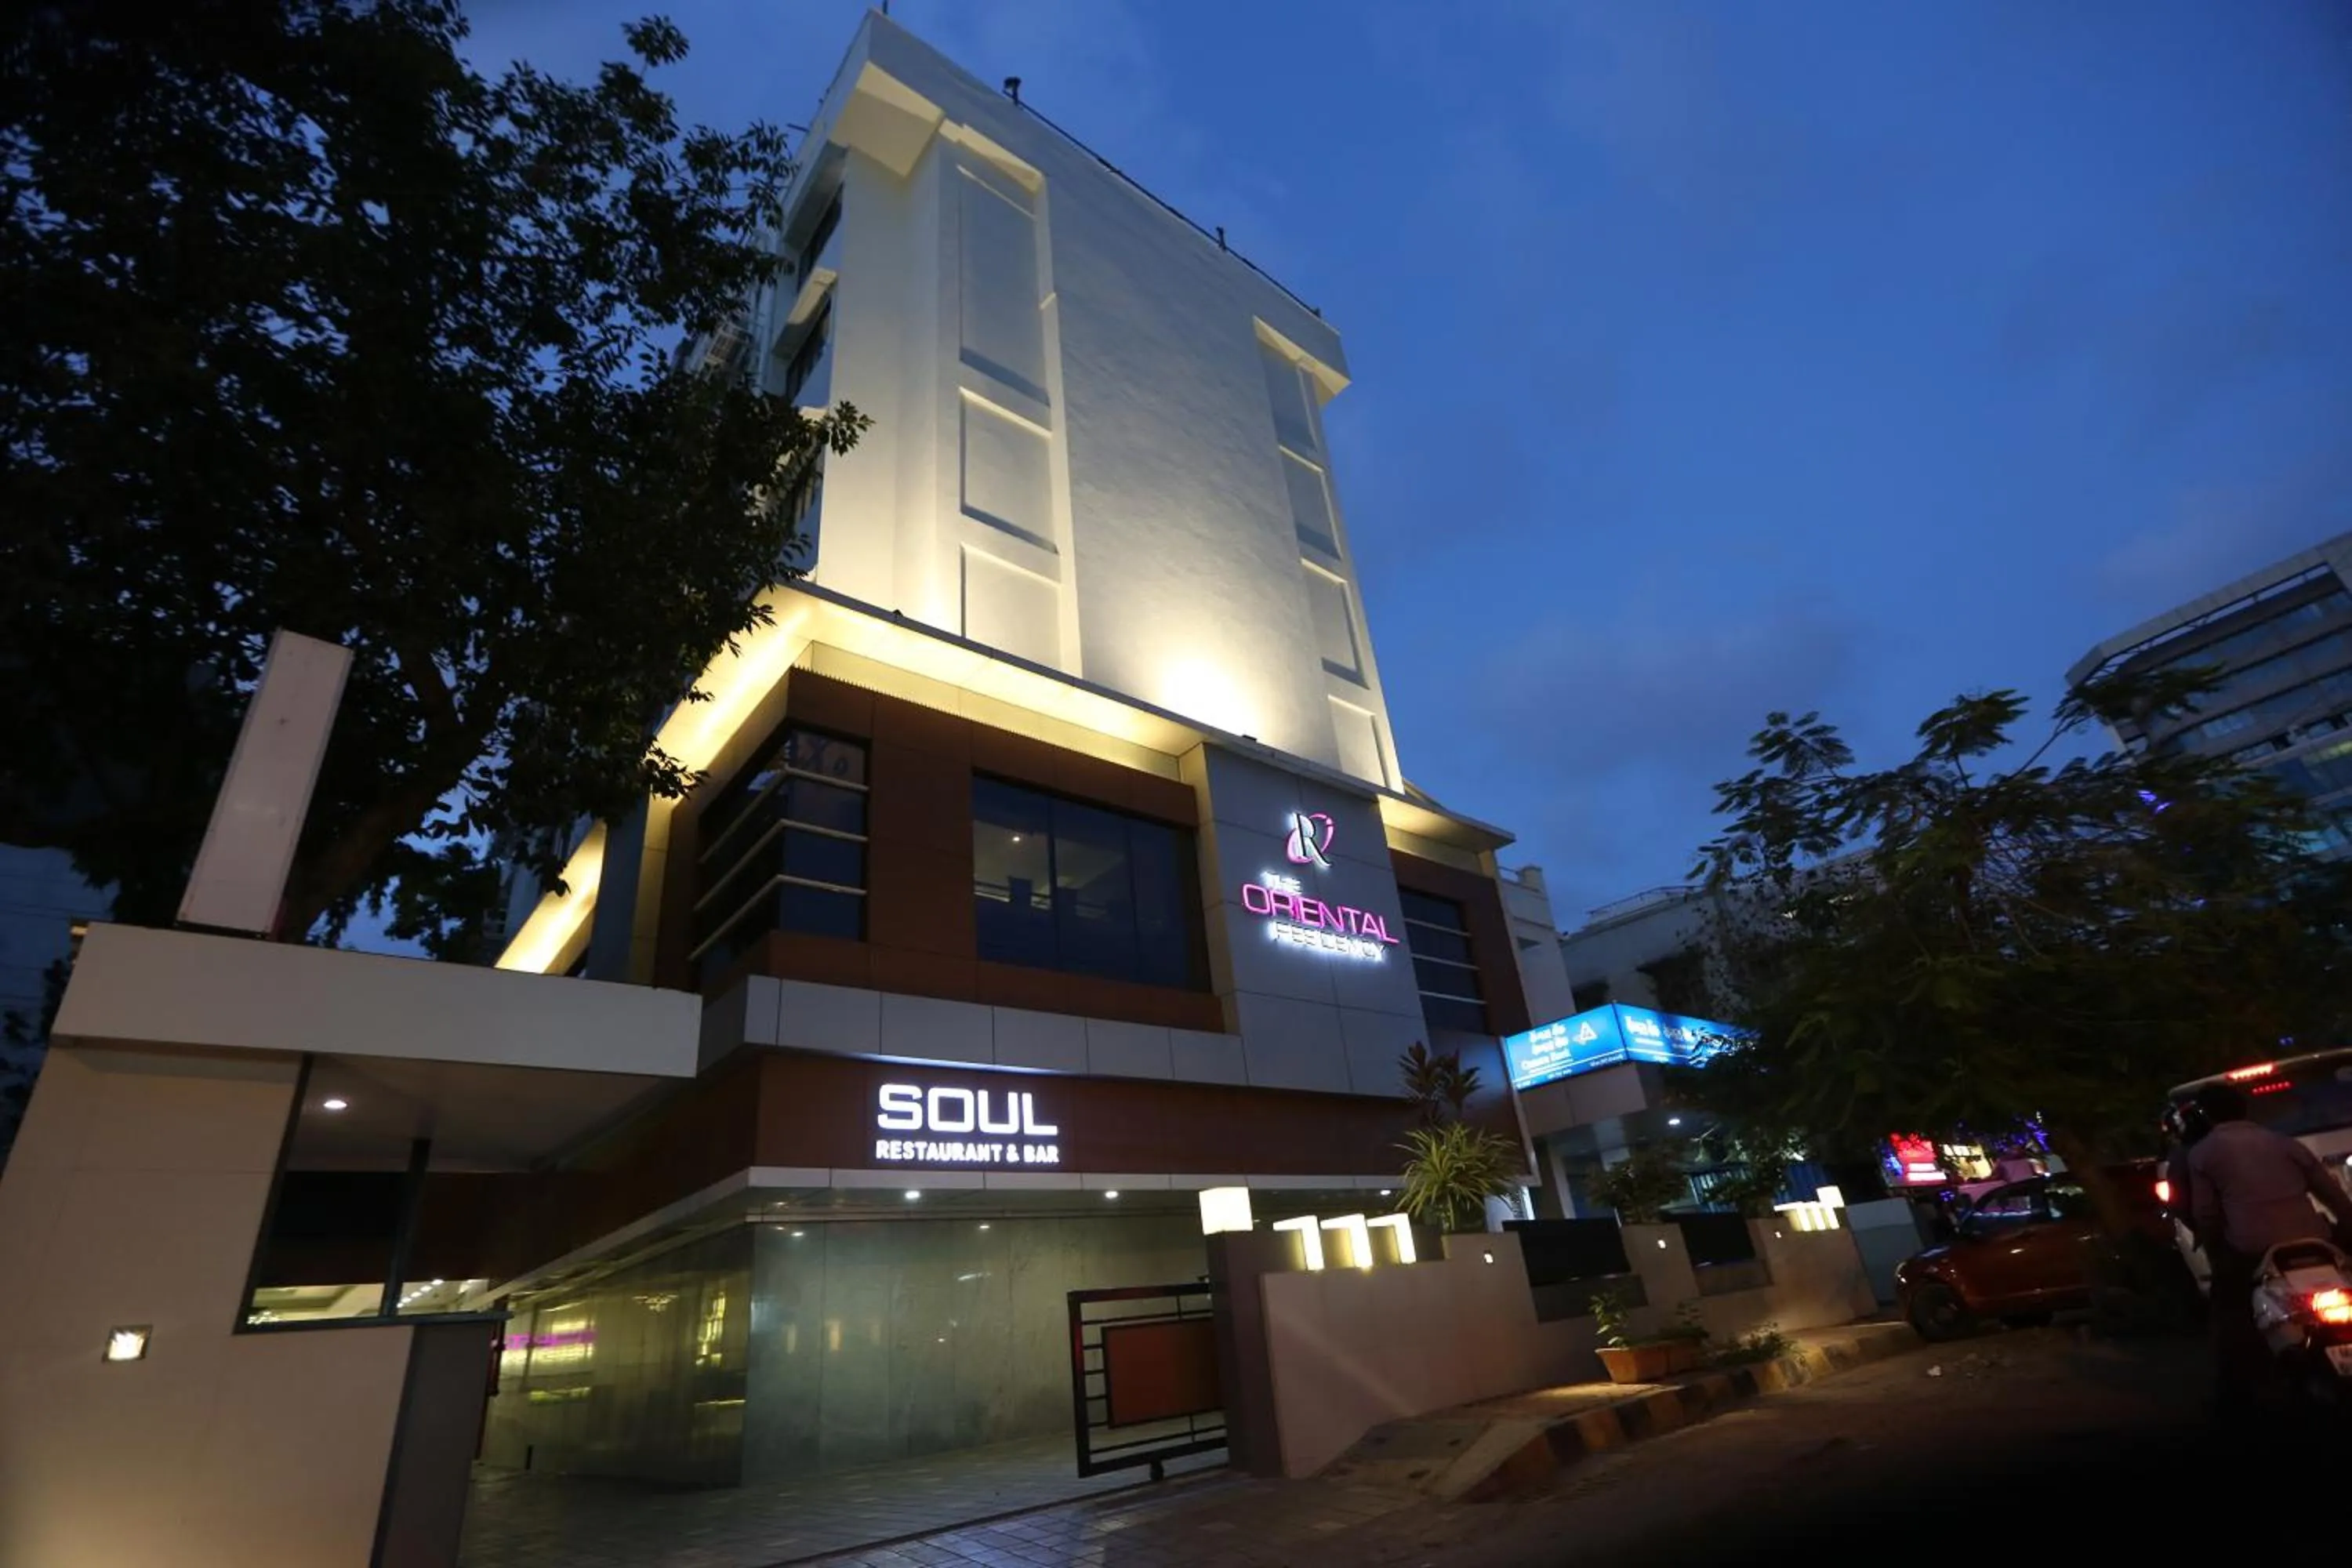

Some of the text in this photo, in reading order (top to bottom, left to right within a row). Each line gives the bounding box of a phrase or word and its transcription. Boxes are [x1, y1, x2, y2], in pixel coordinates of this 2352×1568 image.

[1243, 884, 1399, 944] ORIENTAL
[877, 1083, 1058, 1136] SOUL
[875, 1139, 1060, 1164] RESTAURANT & BAR
